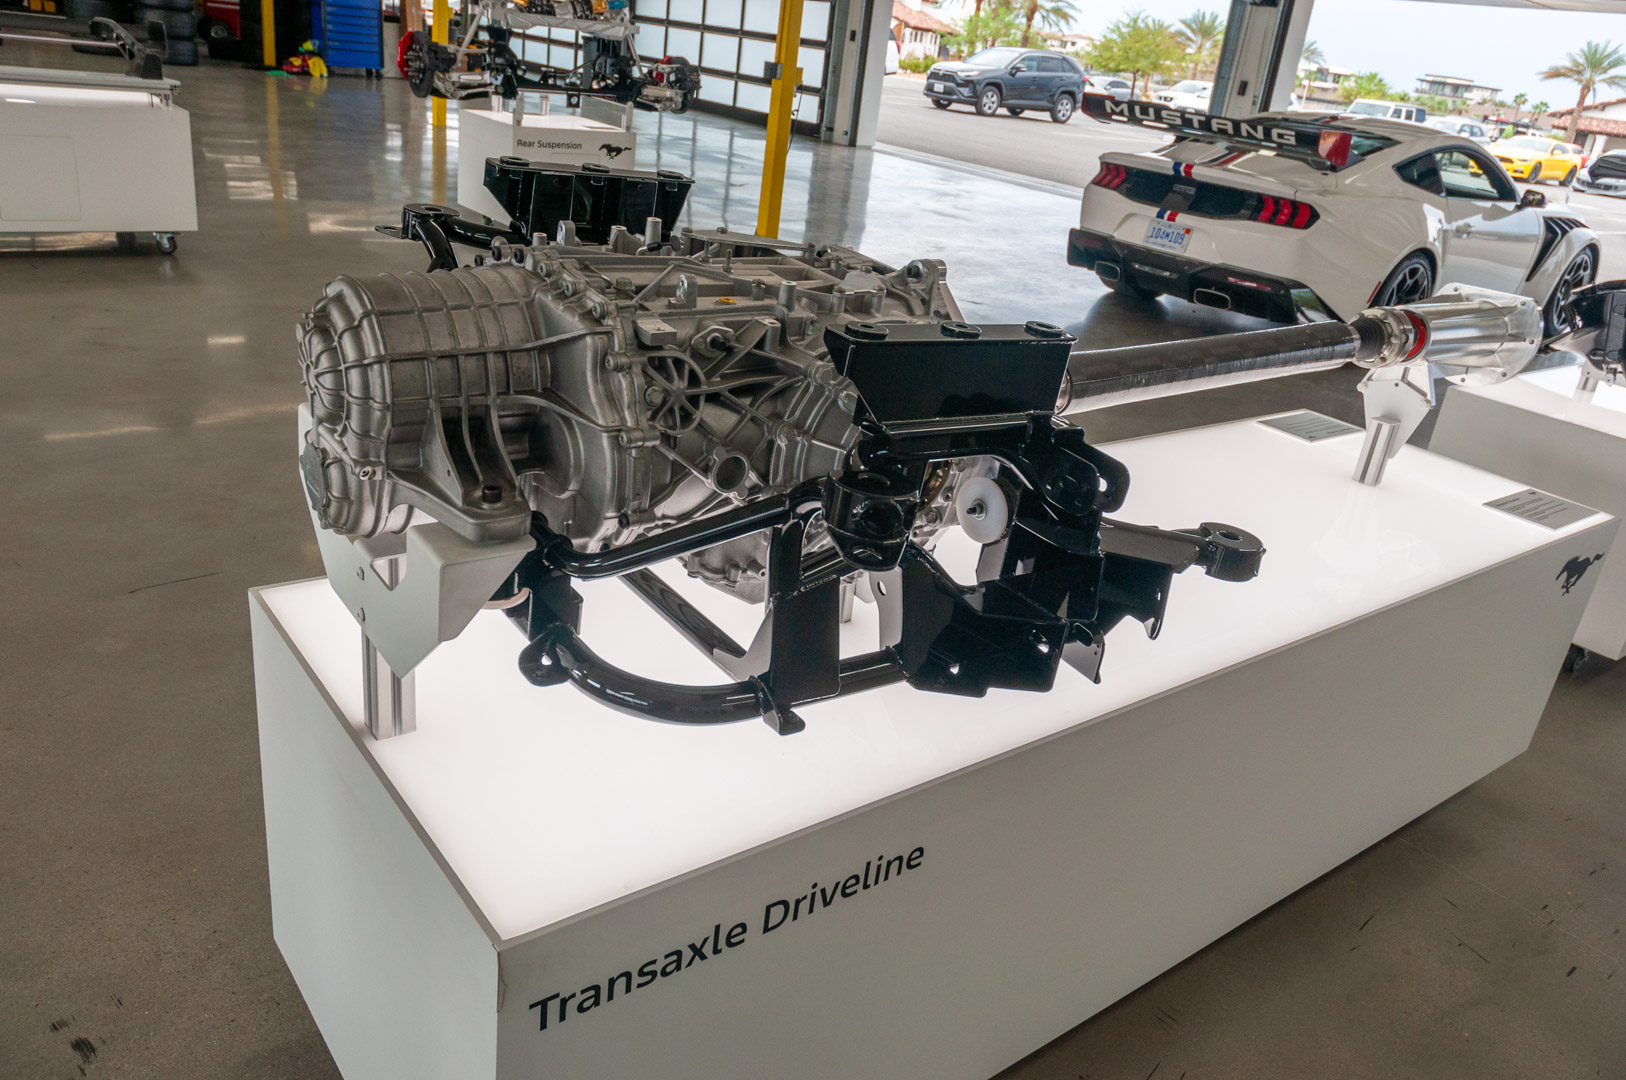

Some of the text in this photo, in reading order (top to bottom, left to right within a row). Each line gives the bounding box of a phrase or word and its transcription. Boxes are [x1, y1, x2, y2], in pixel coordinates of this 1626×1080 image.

[517, 139, 582, 150] Rear Suspension
[1104, 99, 1296, 146] MUSTANG
[528, 846, 925, 1032] Transaxle Driveline
